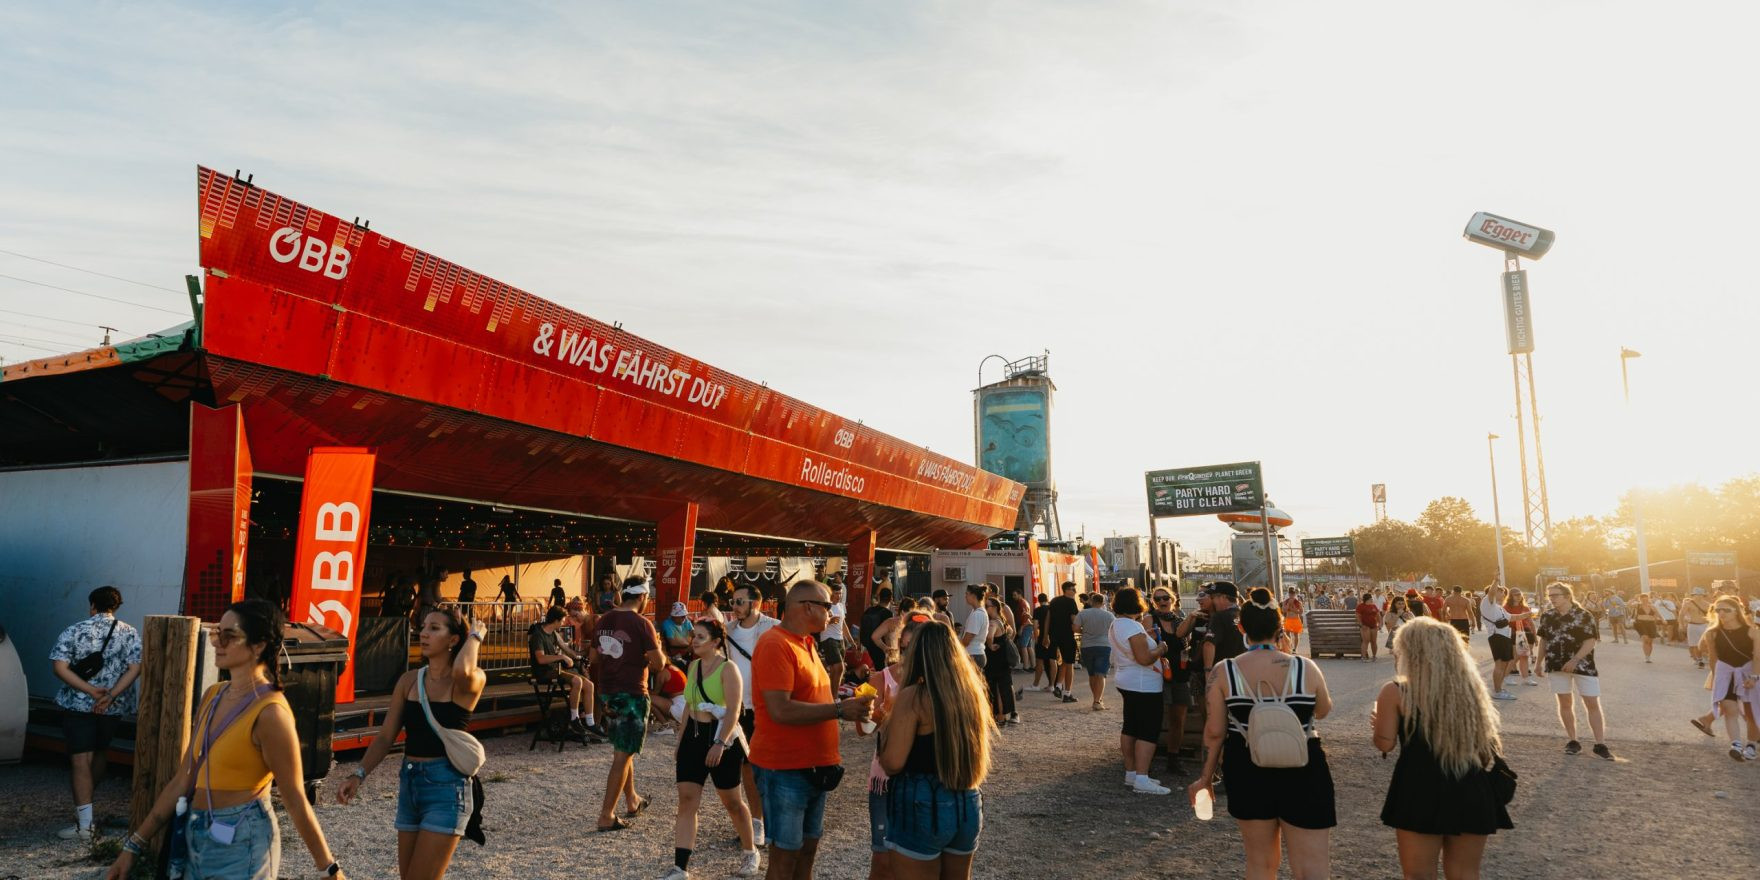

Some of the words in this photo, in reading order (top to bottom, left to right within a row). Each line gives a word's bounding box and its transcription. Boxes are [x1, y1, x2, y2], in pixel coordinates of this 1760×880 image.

[1480, 218, 1532, 245] Egger
[269, 226, 352, 280] ÖBB
[1511, 273, 1521, 290] BIER
[1512, 290, 1523, 315] GUTES
[1515, 316, 1527, 348] RICHTIG
[532, 322, 555, 356] &
[556, 329, 611, 374] WAS
[612, 348, 691, 395] FÄHRST
[687, 377, 725, 410] DU?
[834, 427, 855, 449] ÖBB
[801, 457, 865, 494] Rollerdisco
[923, 461, 943, 481] WAS
[1215, 471, 1234, 479] PLANET
[1175, 487, 1203, 498] PARTY
[1205, 485, 1231, 496] HARD
[1176, 498, 1195, 509] BUT
[1199, 496, 1232, 507] CLEAN
